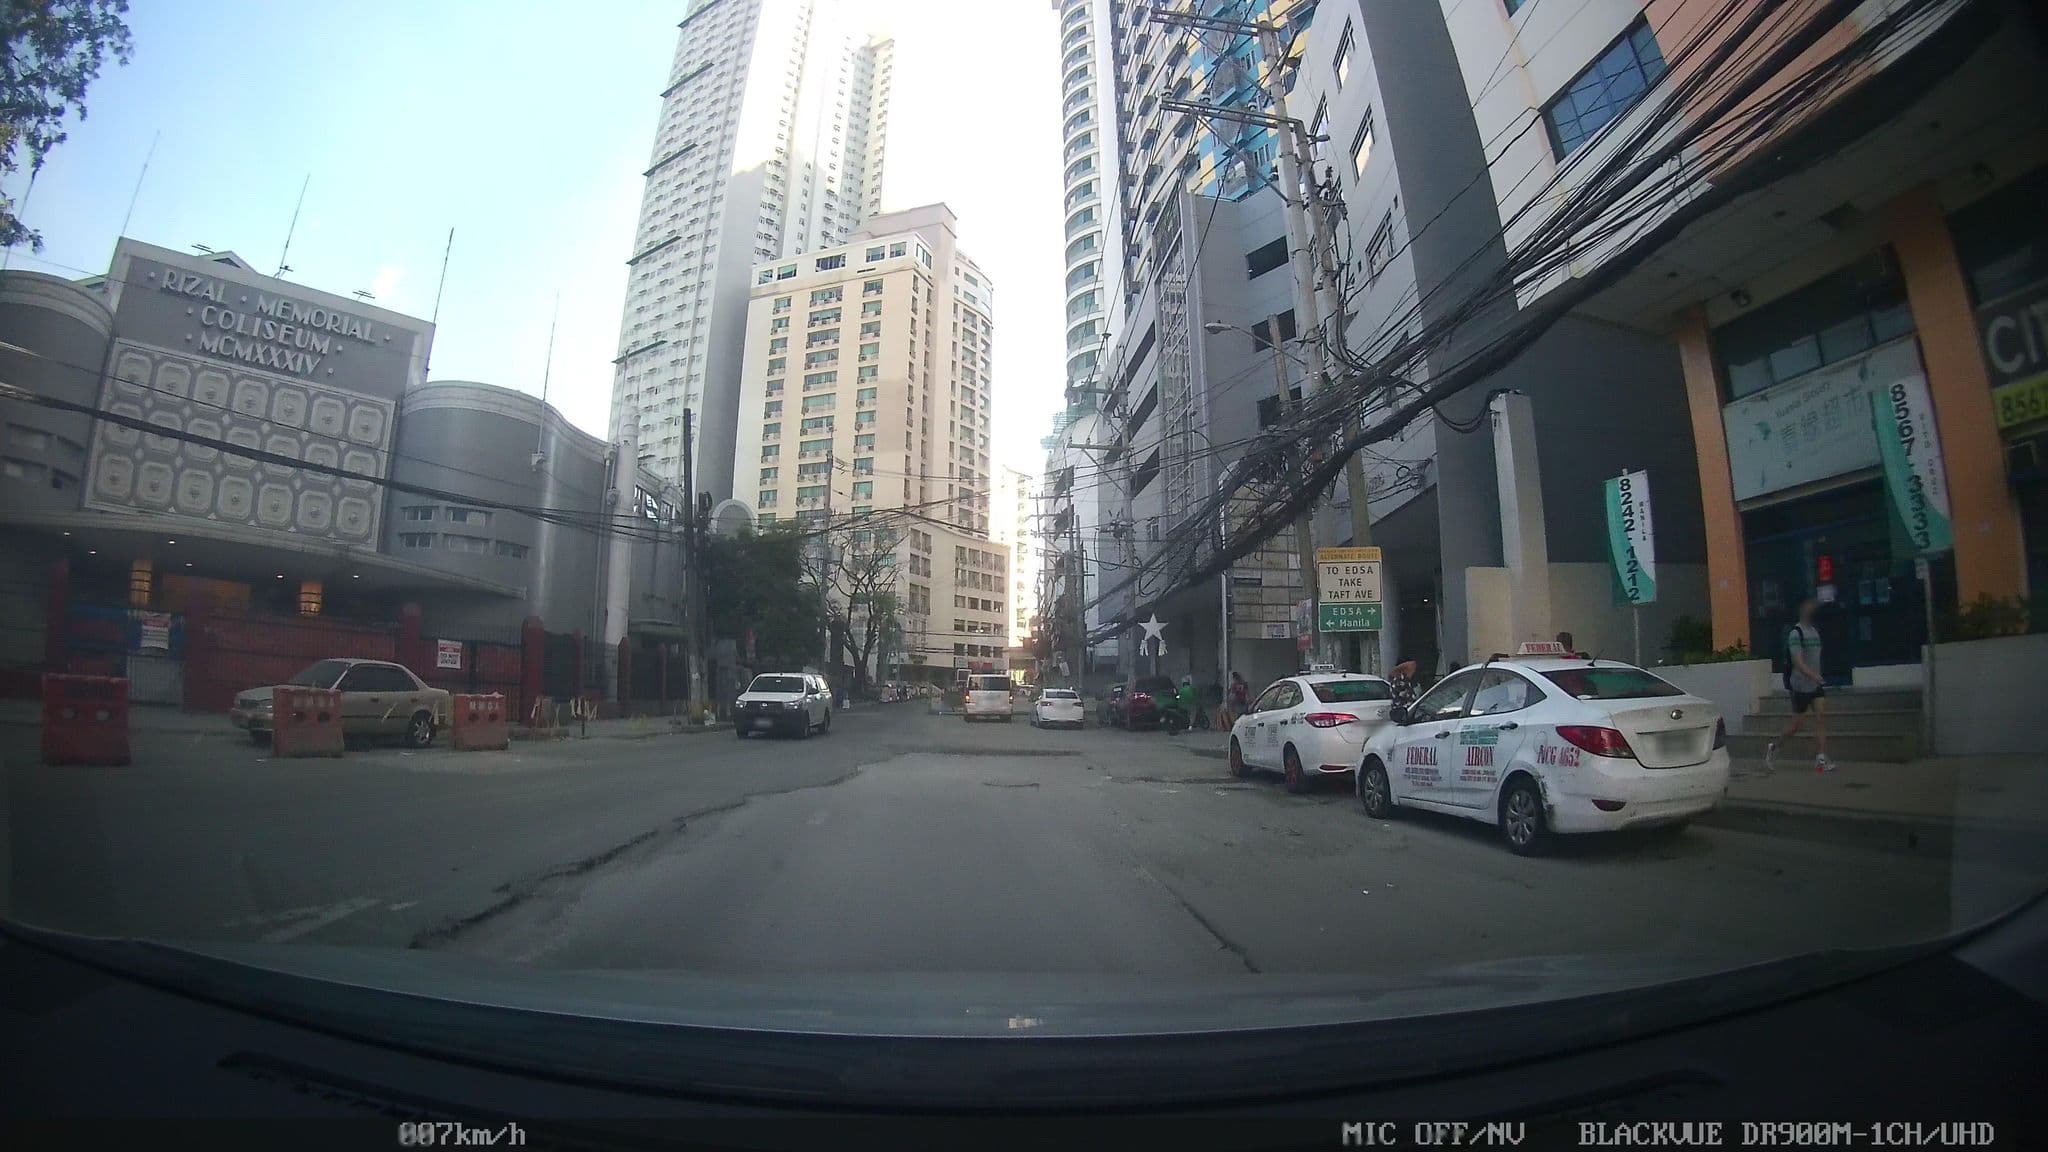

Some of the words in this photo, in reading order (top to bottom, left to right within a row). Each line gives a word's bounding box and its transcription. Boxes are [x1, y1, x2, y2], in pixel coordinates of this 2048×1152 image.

[162, 268, 228, 303] RIZAL
[257, 293, 376, 343] MEMORIAL
[201, 305, 331, 354] COLISEUM
[200, 331, 322, 375] MCMXXXIV
[2001, 387, 2048, 423] 856
[1619, 478, 1640, 601] 8242-1212
[1326, 566, 1339, 575] TO
[1345, 566, 1374, 575] EDSA
[1338, 578, 1362, 587] TAKE
[1328, 590, 1350, 599] TAFT
[1354, 590, 1373, 599] AVE
[1333, 607, 1362, 616] EDSA
[1339, 618, 1370, 627] Manila
[1406, 746, 1439, 766] FEDERAL
[1465, 745, 1495, 767] AIRCON
